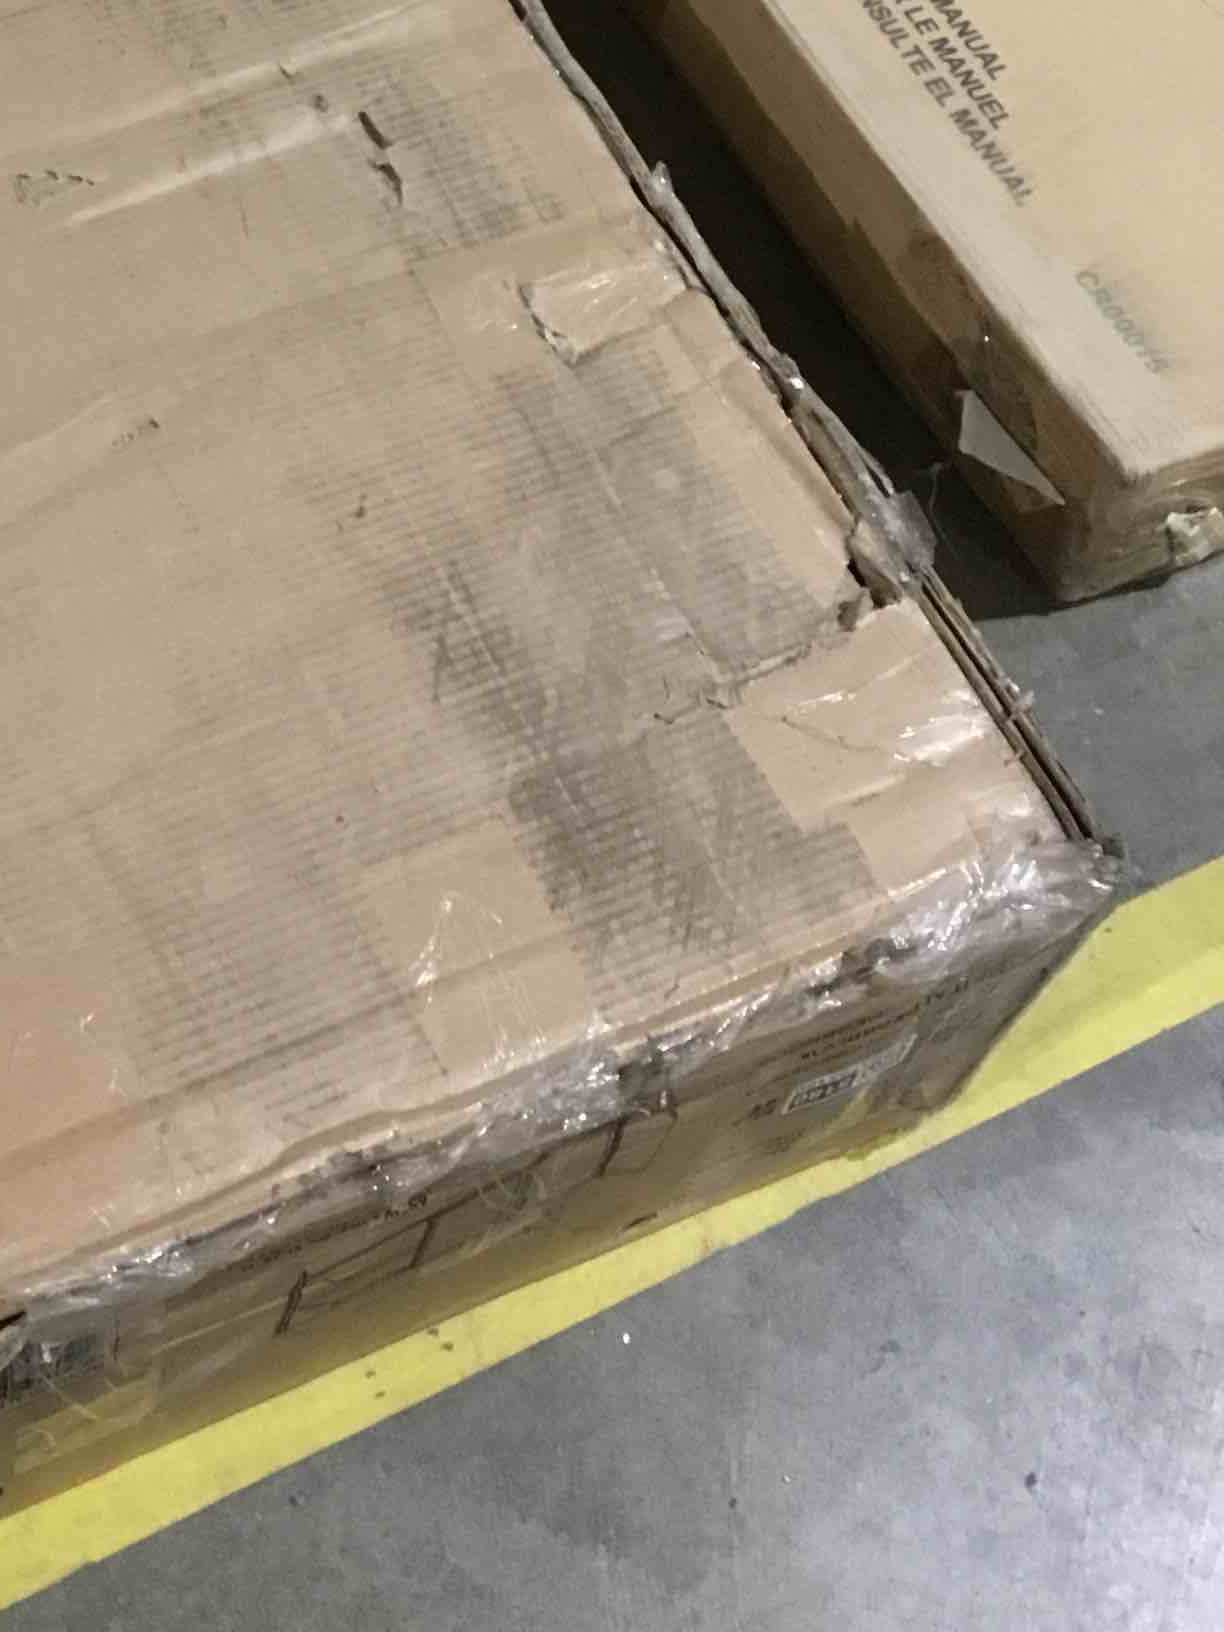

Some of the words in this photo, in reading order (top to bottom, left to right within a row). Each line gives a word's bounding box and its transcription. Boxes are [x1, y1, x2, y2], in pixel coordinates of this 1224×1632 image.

[903, 6, 940, 35] LE
[928, 36, 1010, 130] MANUEL
[924, 76, 956, 109] EL
[949, 108, 1033, 207] MANUAL
